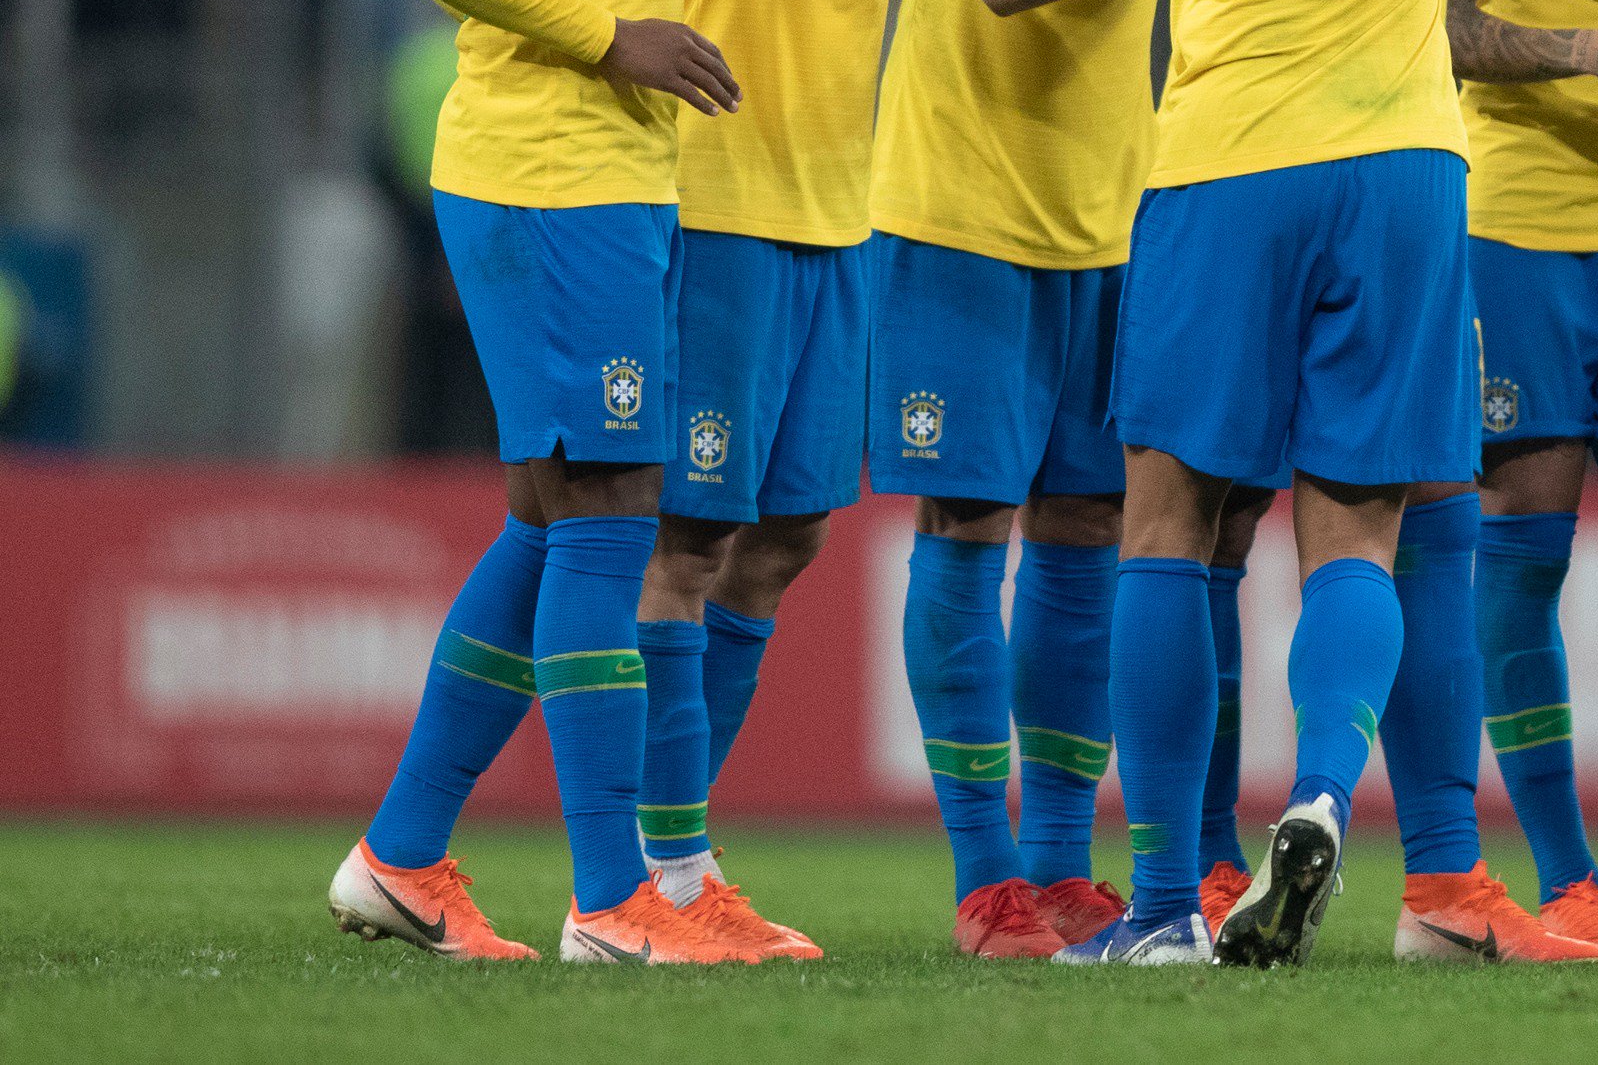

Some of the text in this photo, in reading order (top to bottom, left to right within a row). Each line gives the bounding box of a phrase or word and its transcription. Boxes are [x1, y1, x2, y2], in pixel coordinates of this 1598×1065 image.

[605, 419, 640, 430] BRASIL
[902, 448, 939, 459] BRASIL
[687, 471, 724, 484] BRASIL
